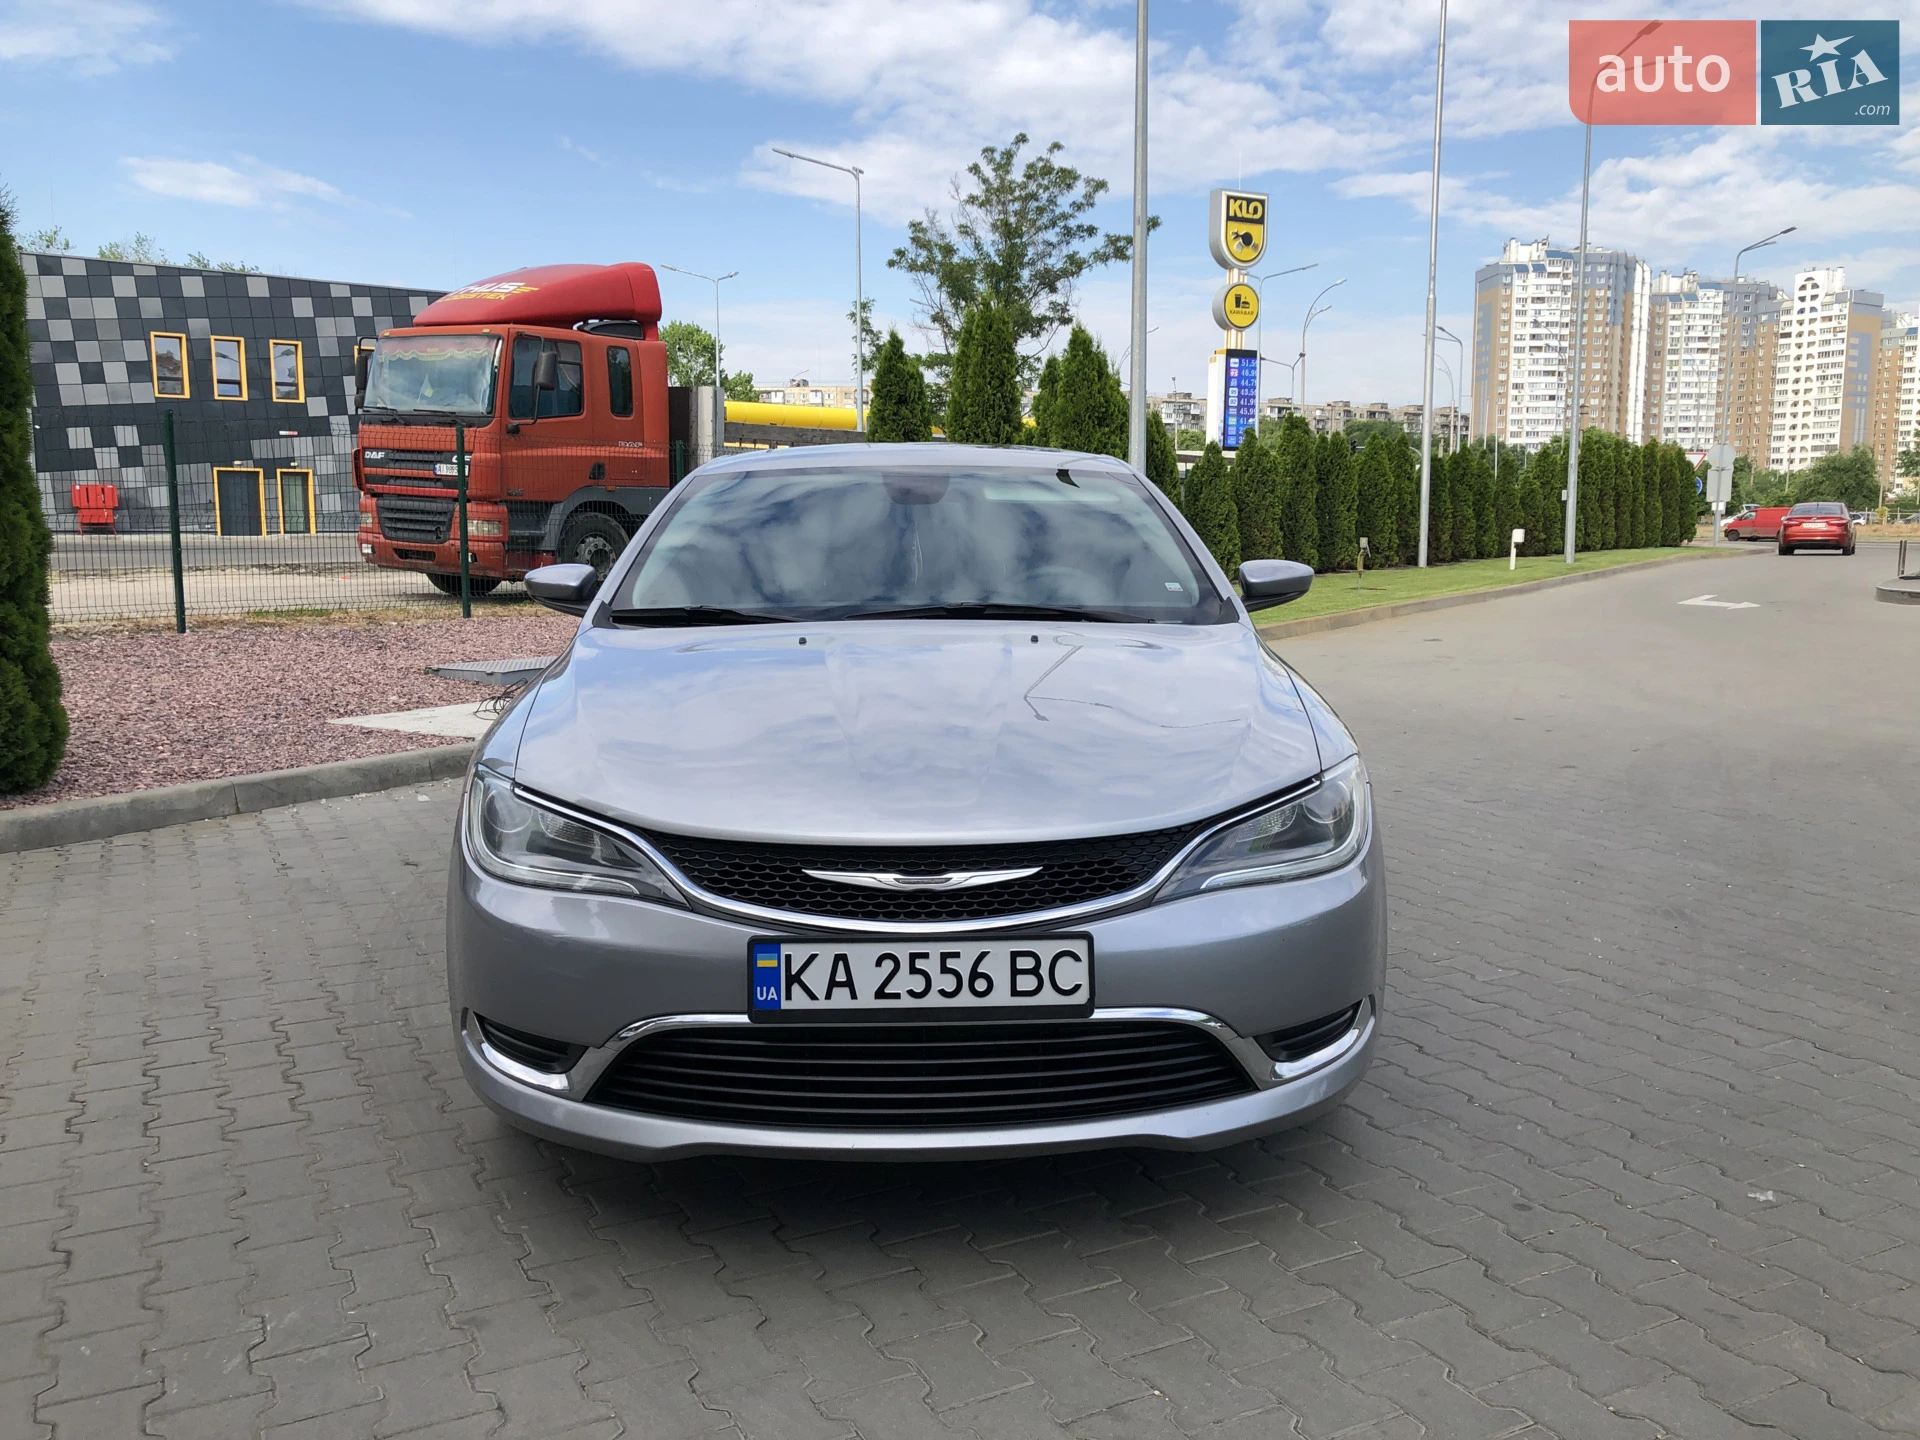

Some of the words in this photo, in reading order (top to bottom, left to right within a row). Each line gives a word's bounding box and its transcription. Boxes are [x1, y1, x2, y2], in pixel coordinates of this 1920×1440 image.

[1229, 198, 1263, 219] KLO
[364, 451, 385, 459] DAF
[756, 986, 778, 1001] UA
[784, 952, 858, 1001] KA
[873, 950, 995, 1000] 2556
[1009, 949, 1083, 998] BC
